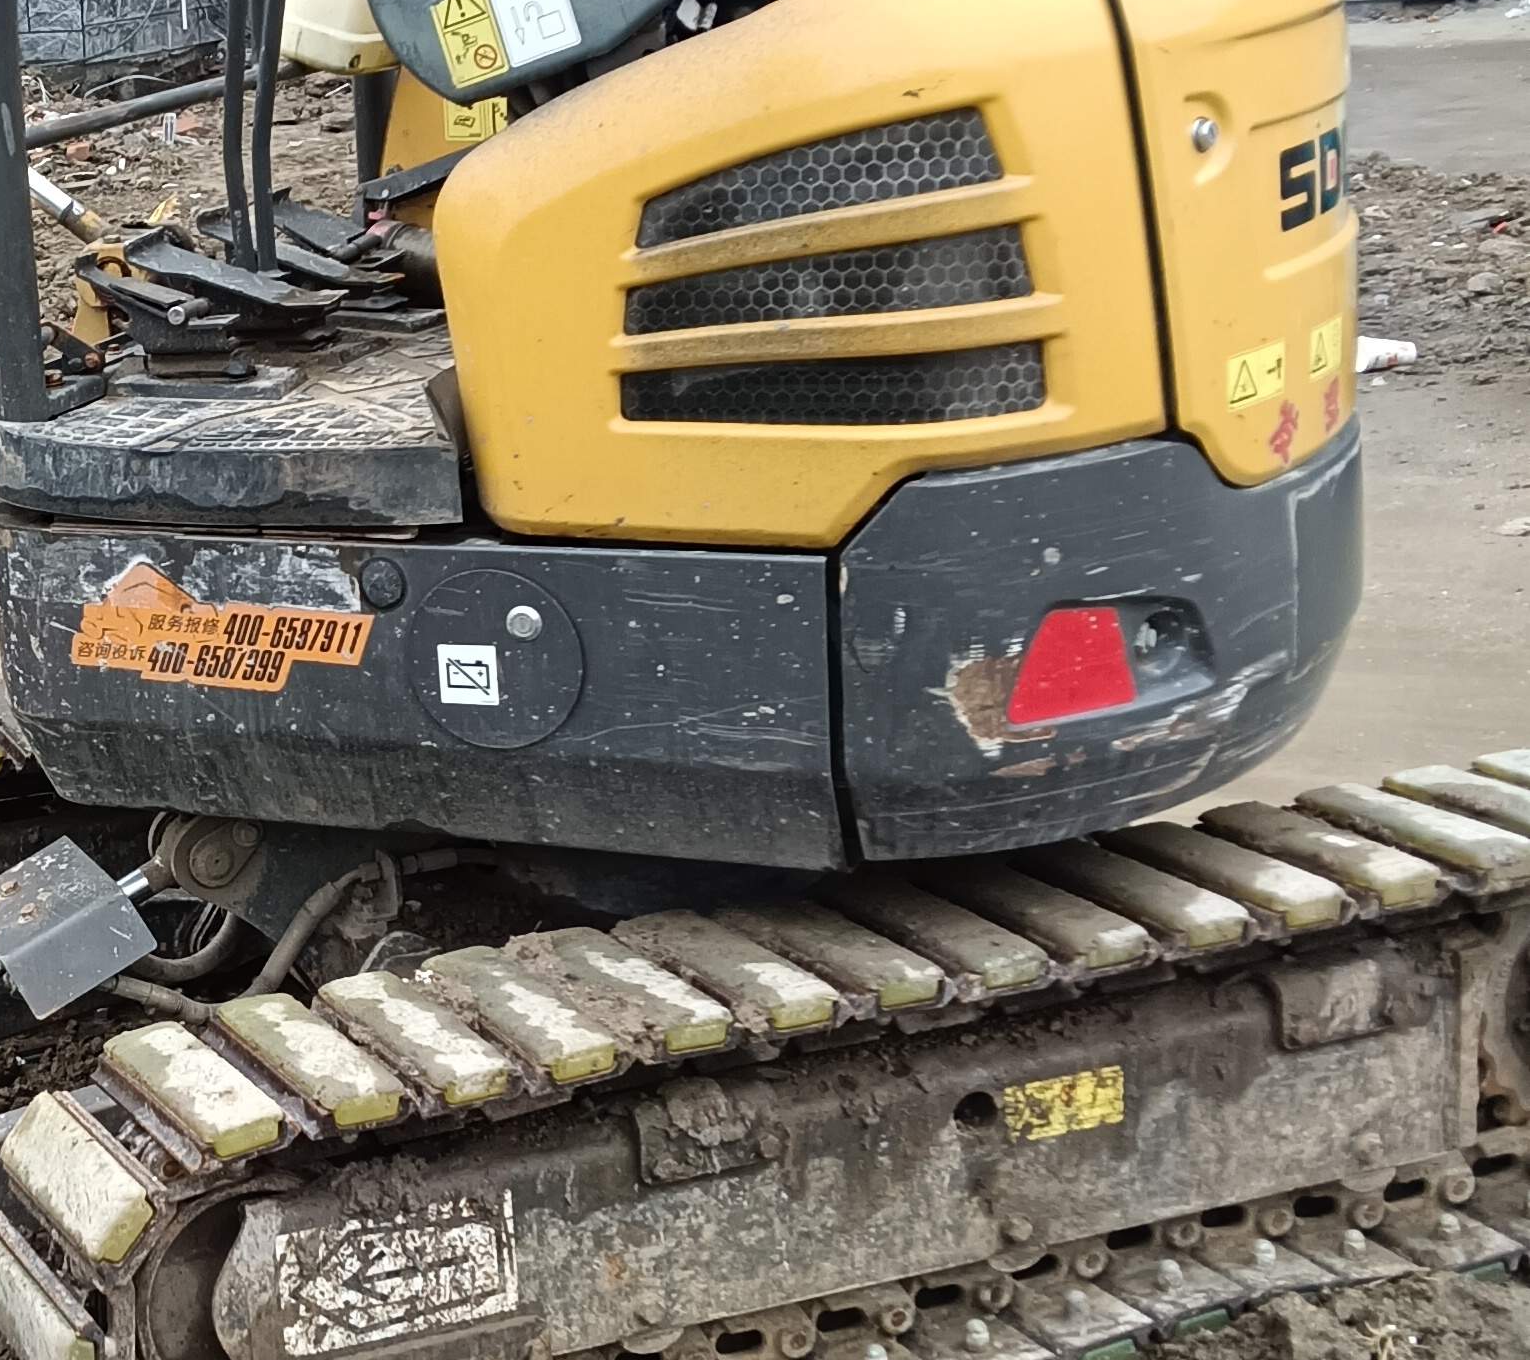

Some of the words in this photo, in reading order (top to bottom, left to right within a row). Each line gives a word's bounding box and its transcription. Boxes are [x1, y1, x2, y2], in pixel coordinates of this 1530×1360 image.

[1279, 126, 1350, 232] SD
[147, 613, 220, 635] 服务报修
[223, 613, 363, 654] 400-6587911
[77, 640, 146, 661] 咨询投诉
[147, 641, 286, 683] 400-6587999
